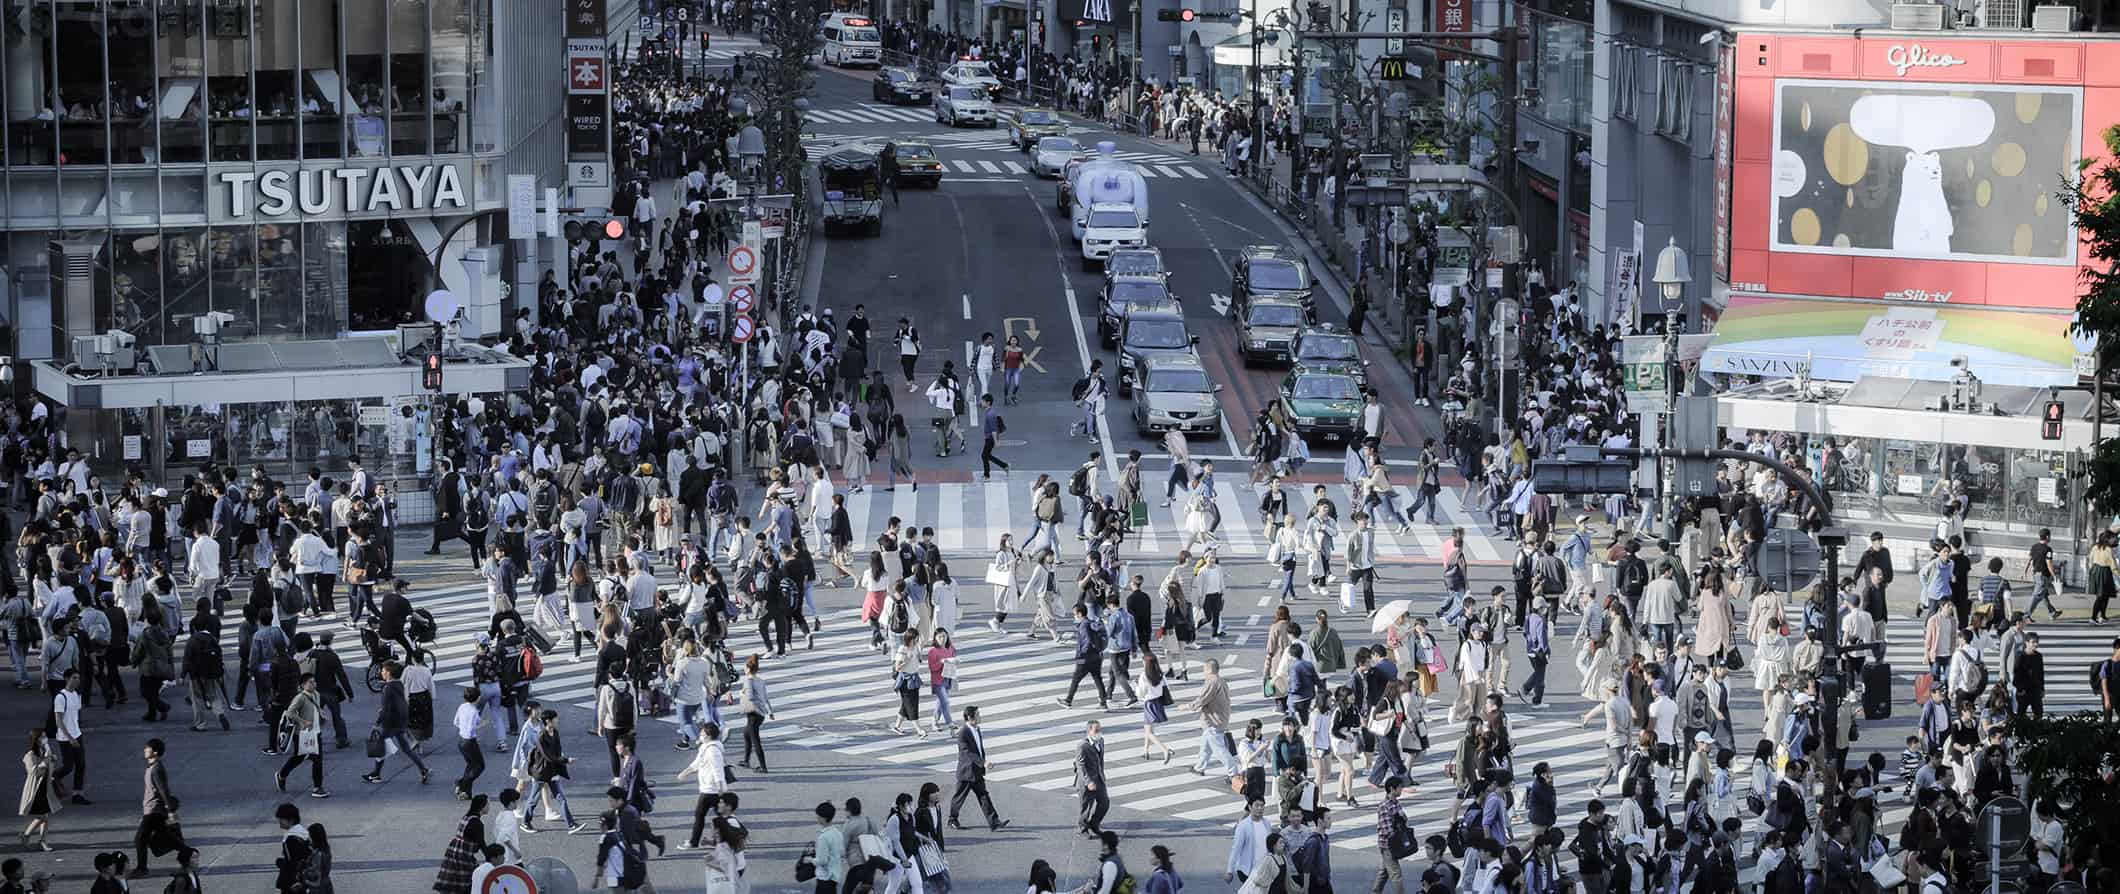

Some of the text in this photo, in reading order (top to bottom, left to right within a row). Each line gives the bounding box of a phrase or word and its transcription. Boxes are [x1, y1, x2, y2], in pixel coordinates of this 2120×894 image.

[1888, 43, 1967, 77] Glico
[574, 61, 600, 87] 本
[573, 116, 601, 124] WIRED
[221, 165, 466, 217] TSUTAYA
[1728, 356, 1811, 376] SANZENR
